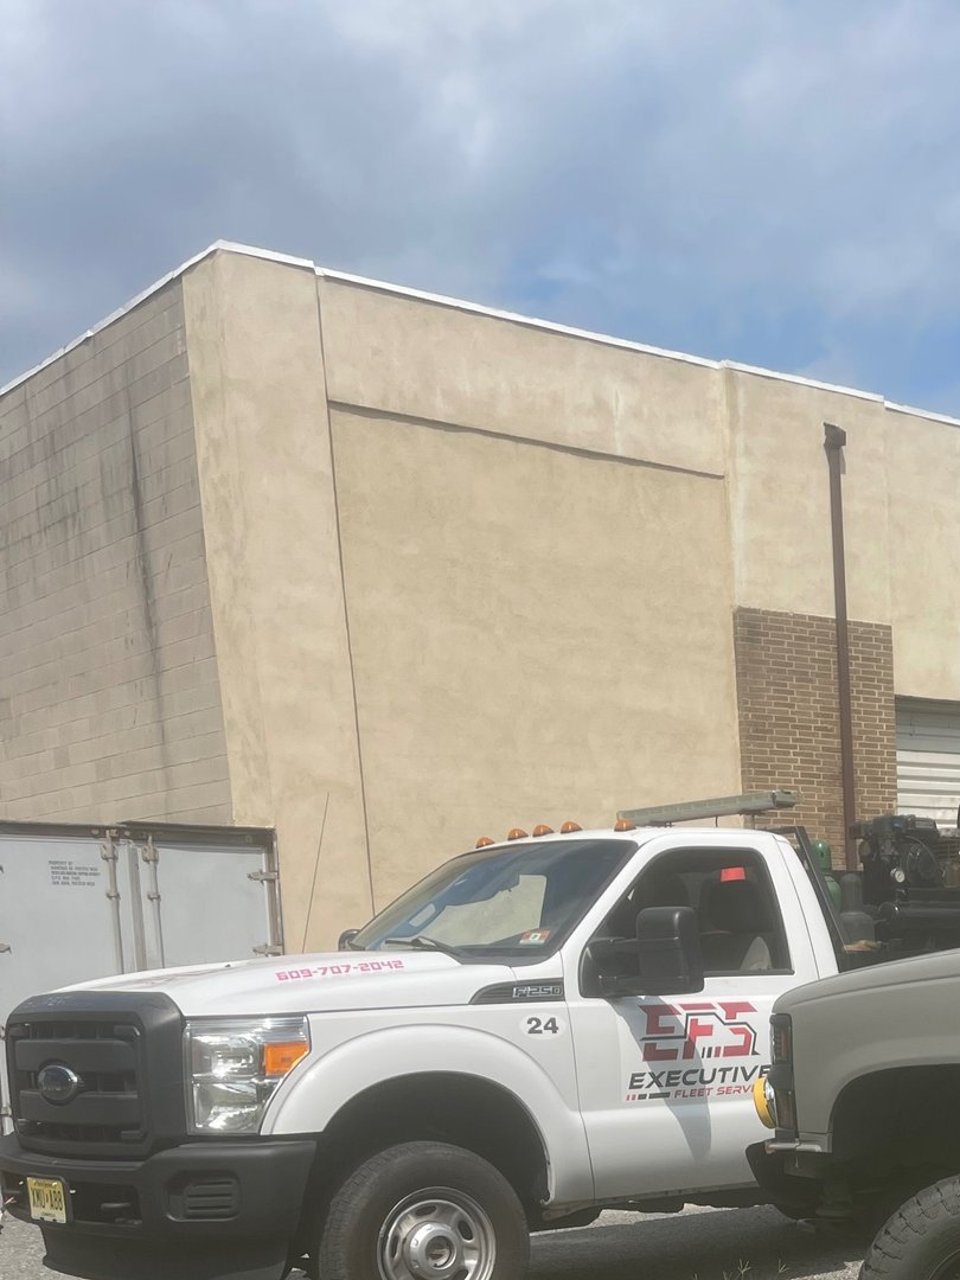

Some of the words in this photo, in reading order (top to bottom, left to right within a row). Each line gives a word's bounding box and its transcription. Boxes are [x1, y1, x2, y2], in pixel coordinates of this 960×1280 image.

[275, 960, 404, 981] 609-707-2042
[527, 1017, 559, 1034] 24
[639, 1001, 760, 1062] EFS
[628, 1064, 771, 1090] EXECUTIVE
[674, 1087, 714, 1099] FLEET
[716, 1083, 754, 1096] SERVI
